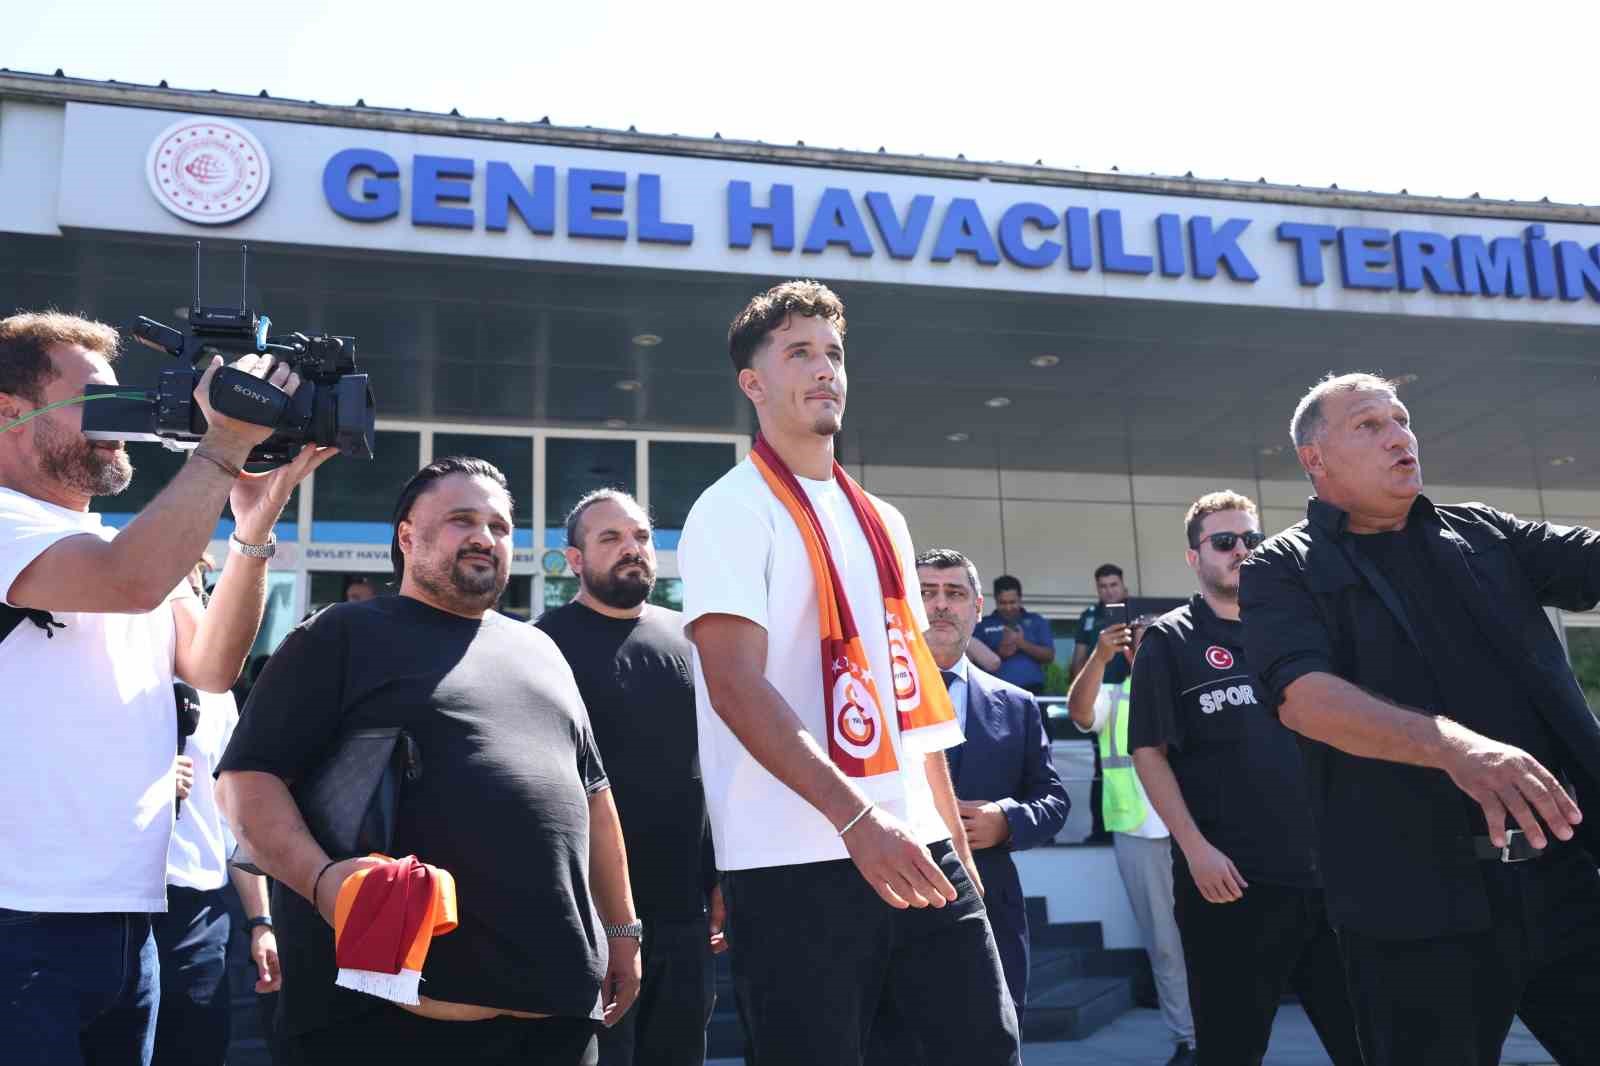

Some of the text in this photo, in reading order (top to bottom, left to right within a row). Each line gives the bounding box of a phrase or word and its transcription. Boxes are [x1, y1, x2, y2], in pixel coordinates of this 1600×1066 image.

[322, 147, 694, 247] GENEL
[727, 179, 1259, 282] HAVACILIK
[1277, 224, 1600, 305] TERMİN
[232, 384, 270, 403] SONY
[306, 549, 354, 559] DEVLET
[1199, 684, 1258, 714] SPOR
